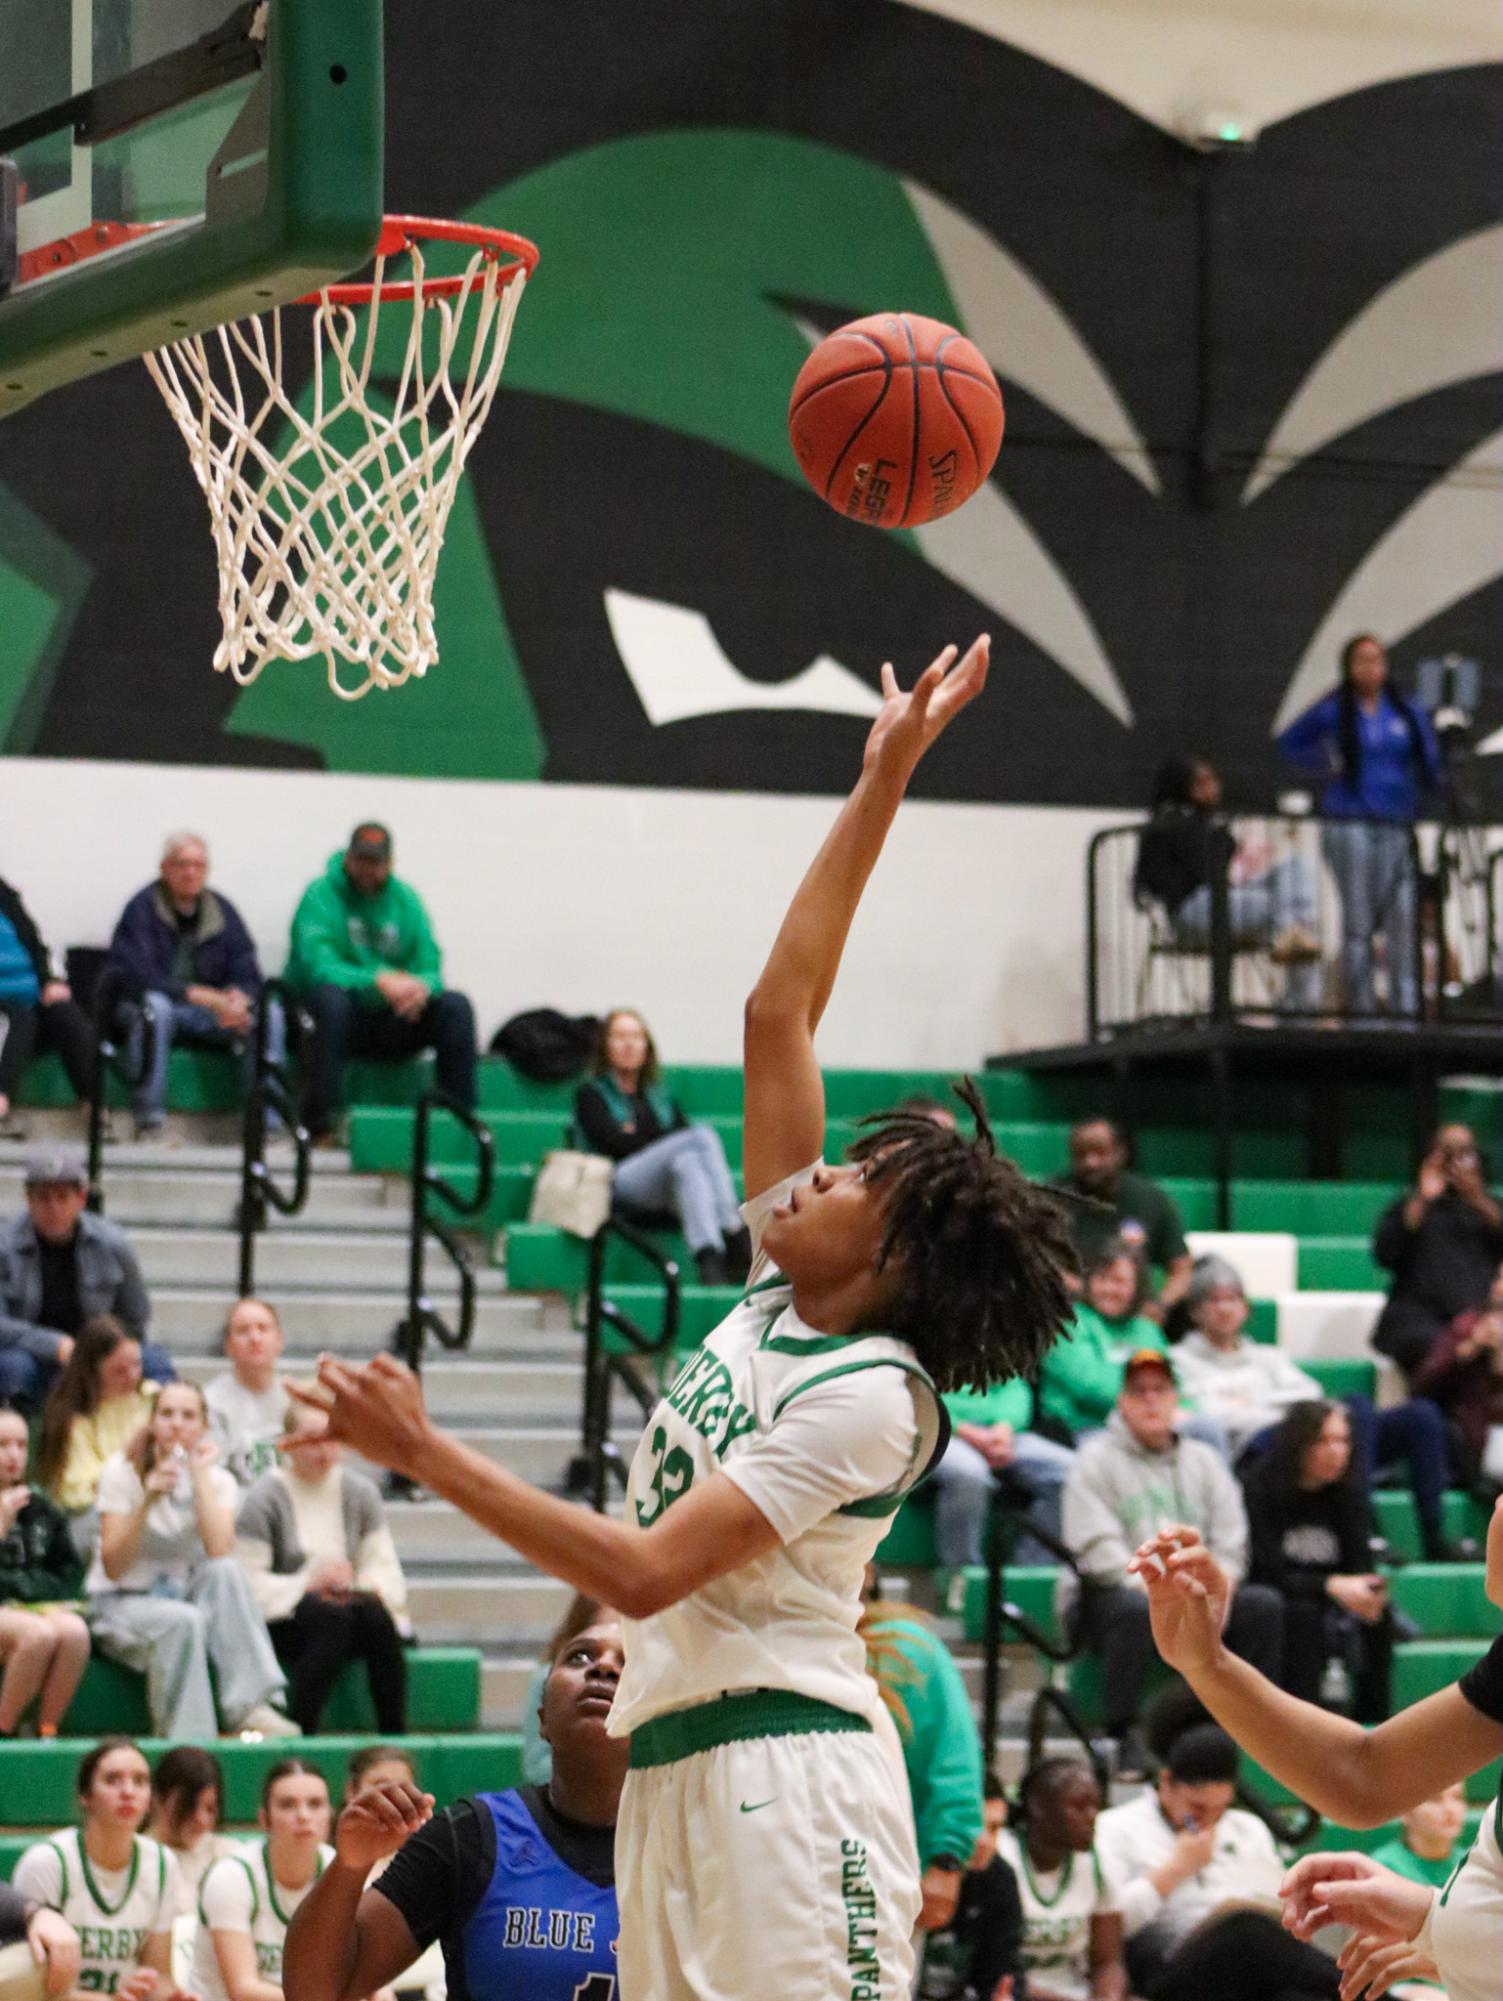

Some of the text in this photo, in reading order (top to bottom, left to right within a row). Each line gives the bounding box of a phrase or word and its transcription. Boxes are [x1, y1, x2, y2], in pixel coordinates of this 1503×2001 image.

[667, 1349, 757, 1463] ERBY
[74, 1925, 146, 1961] ERBY
[503, 1906, 596, 1953] BLUE
[841, 1839, 880, 2001] PANTHERS
